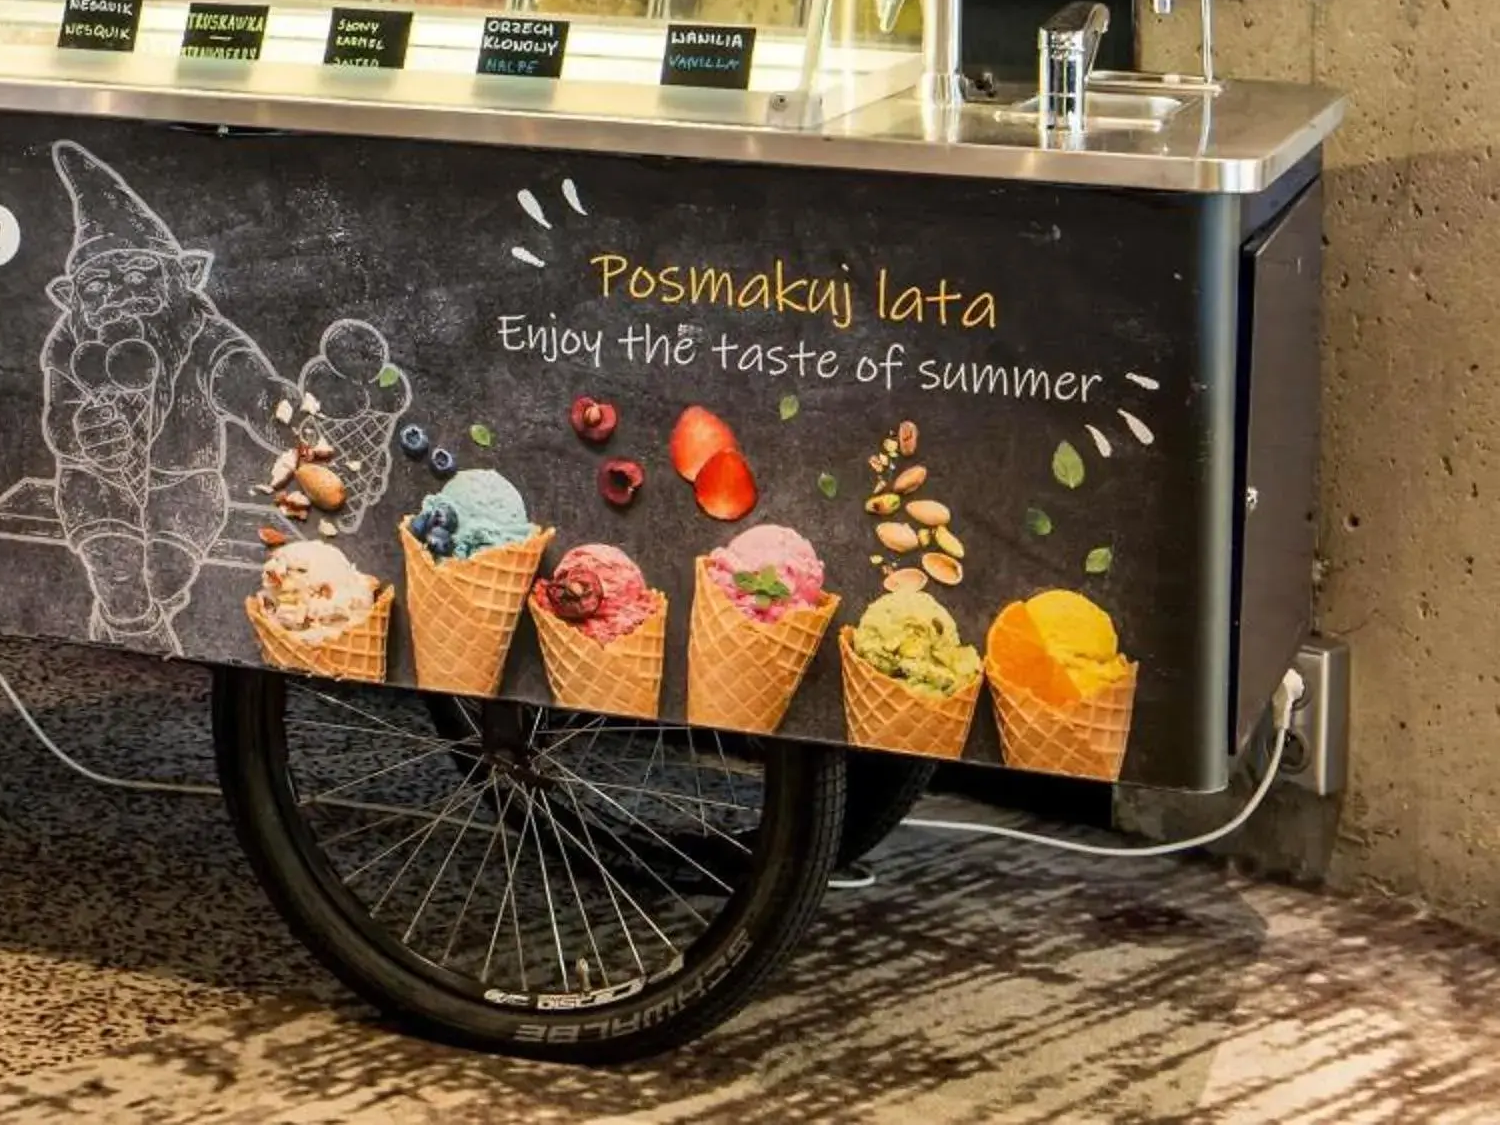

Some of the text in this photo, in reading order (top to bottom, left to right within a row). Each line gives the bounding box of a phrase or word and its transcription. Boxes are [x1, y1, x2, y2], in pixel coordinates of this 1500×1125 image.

[65, 24, 131, 40] NESQUIK
[188, 12, 264, 32] TRUSKAWKA
[487, 20, 554, 38] ORZECH
[483, 35, 559, 56] KLONOWY
[671, 30, 744, 49] WANILIA
[669, 54, 740, 71] VANILLA
[590, 253, 998, 330] Posmakuj lata
[497, 312, 1104, 403] Enjoy the taste of summer
[515, 928, 753, 1043] SCHWALBE
